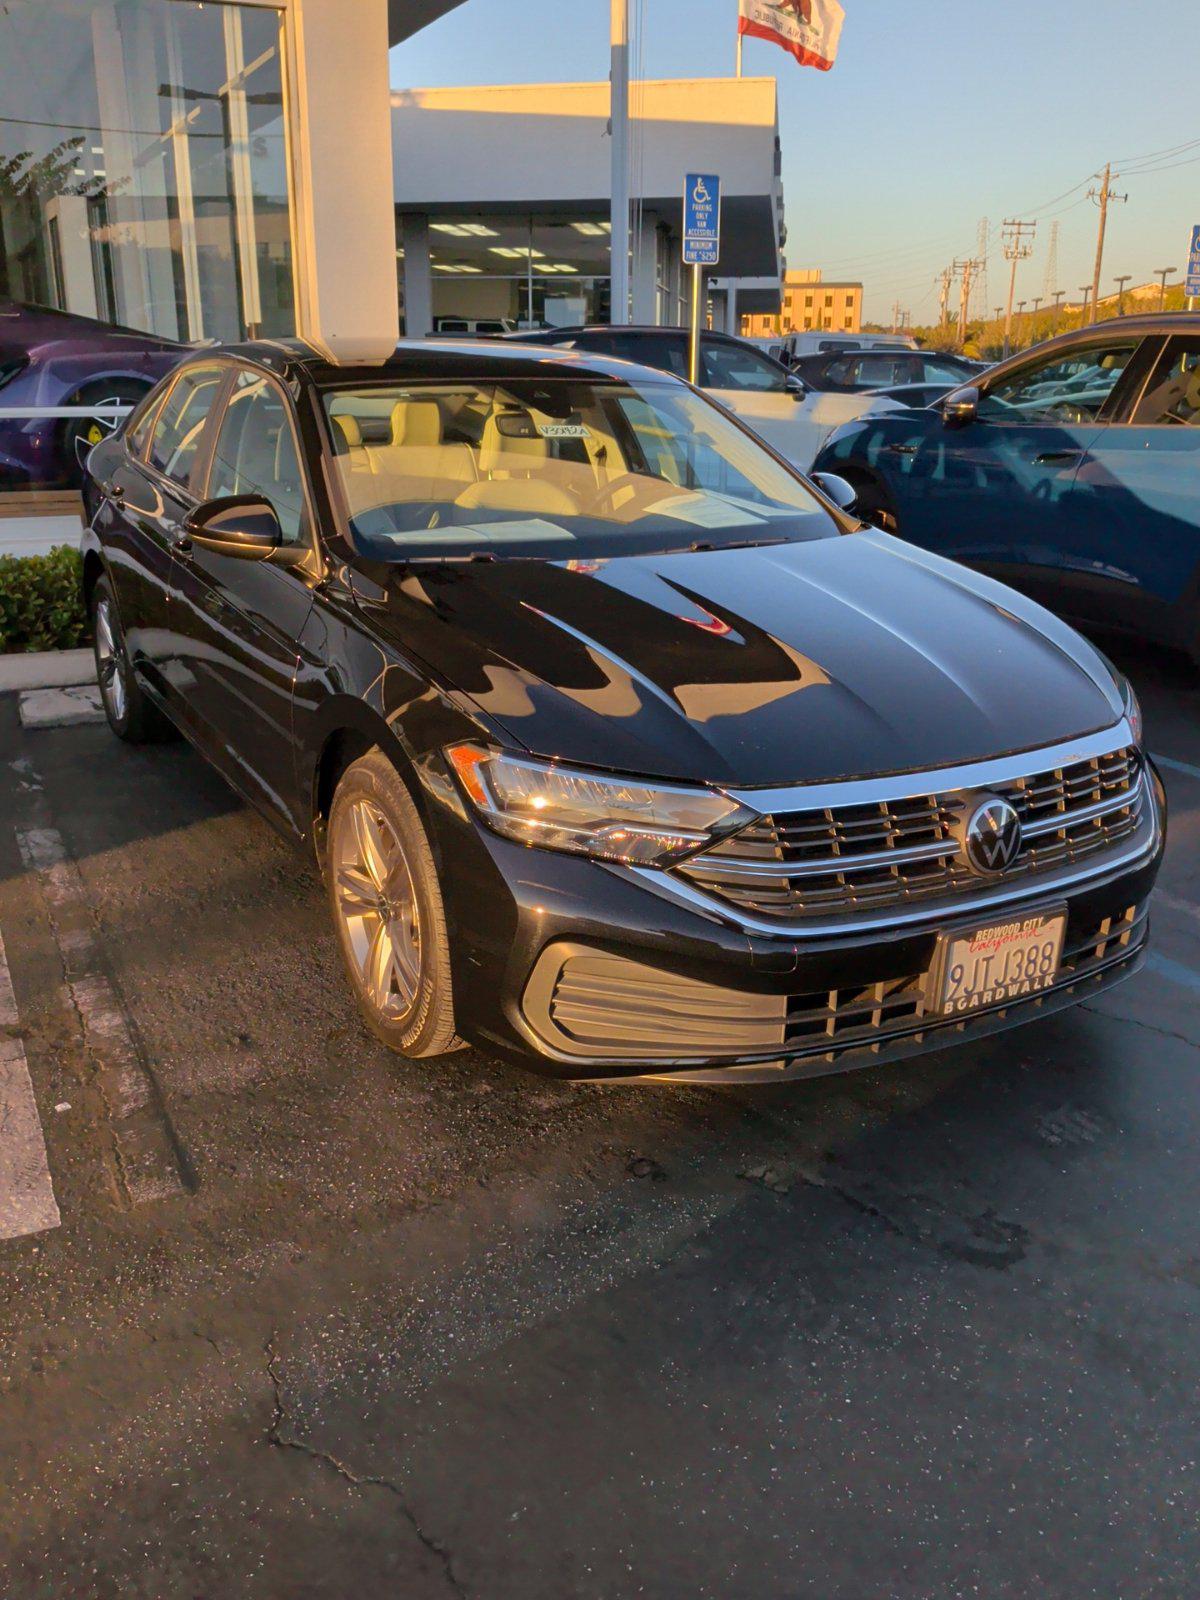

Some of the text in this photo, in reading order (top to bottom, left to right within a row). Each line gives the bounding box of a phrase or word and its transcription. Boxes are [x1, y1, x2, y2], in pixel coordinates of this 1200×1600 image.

[692, 203, 712, 212] PARKING
[695, 212, 708, 220] ONLY
[697, 220, 707, 228] VAN
[687, 228, 715, 237] ACCESSIBLE
[689, 240, 713, 250] MINIMUM
[685, 251, 697, 260] FINE
[975, 916, 1044, 941] REDWOOD CITY
[947, 941, 1055, 1000] 9JTJ388
[943, 973, 1056, 1015] BOARDWALK
